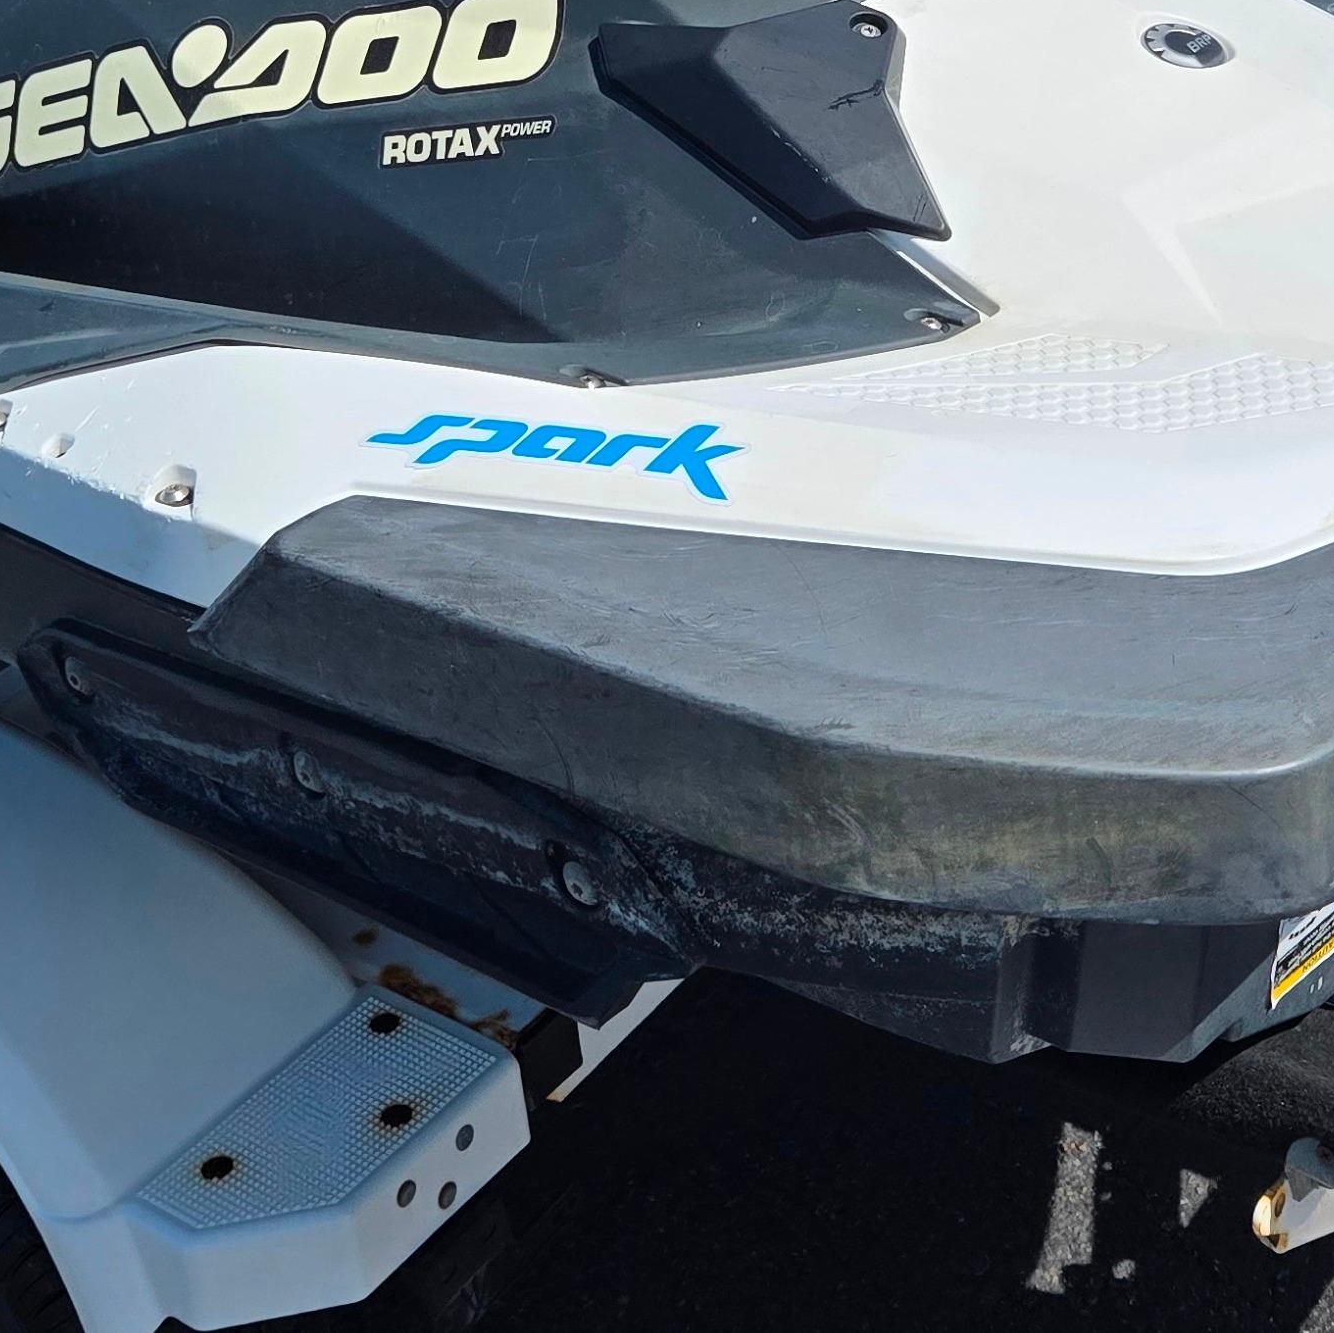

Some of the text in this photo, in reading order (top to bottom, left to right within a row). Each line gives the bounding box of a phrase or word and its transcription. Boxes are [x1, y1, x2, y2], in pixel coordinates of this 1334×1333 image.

[1186, 34, 1212, 53] BRP
[382, 120, 552, 166] ROTAX POWER
[366, 414, 746, 501] spark
